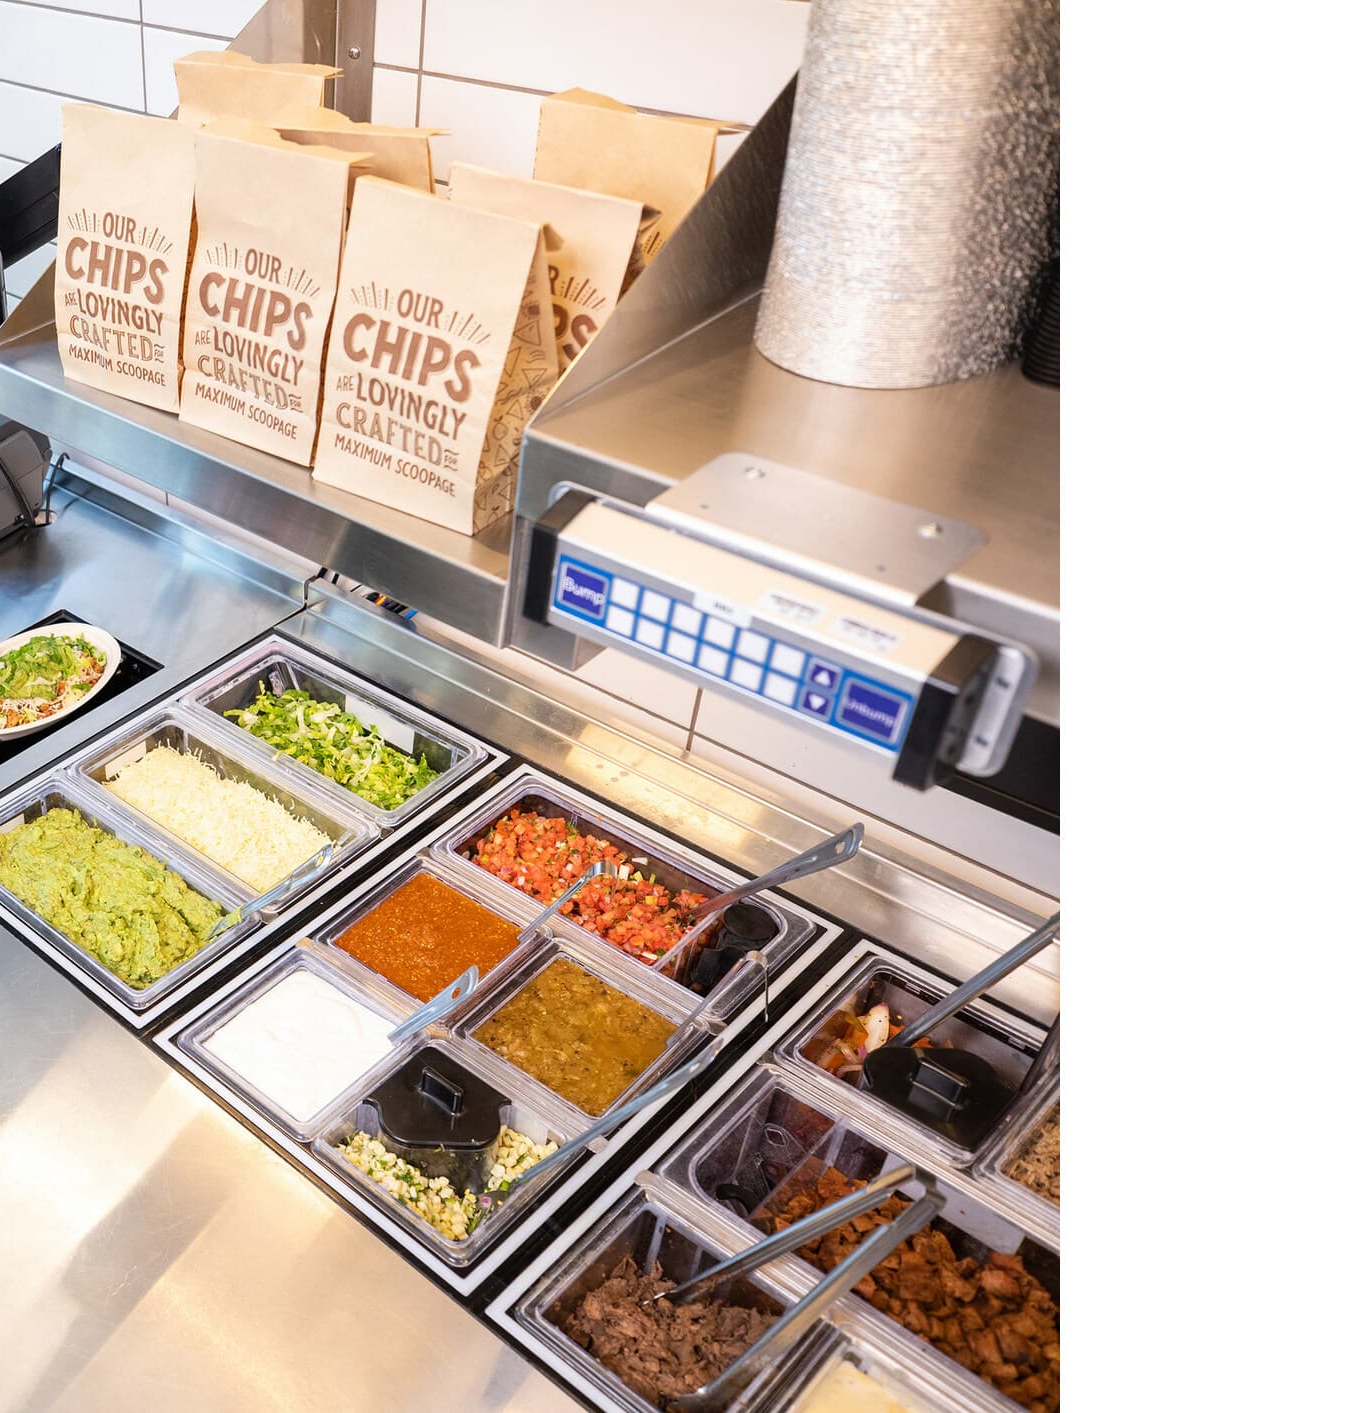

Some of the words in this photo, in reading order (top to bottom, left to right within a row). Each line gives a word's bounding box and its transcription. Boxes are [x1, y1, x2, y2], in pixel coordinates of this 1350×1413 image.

[102, 212, 136, 244] OUR
[65, 236, 169, 304] CHIPS
[245, 248, 282, 284] OUR
[65, 292, 77, 306] ARE
[77, 288, 163, 336] LOVINGLY
[199, 272, 313, 352] CHIPS
[397, 289, 443, 329] OUR
[69, 315, 153, 362] CRAFTED
[69, 344, 113, 372] MAXIMUM
[116, 361, 166, 386] SCOOPAGE
[195, 330, 211, 345] ARE
[213, 326, 304, 386] LOVINGLY
[343, 312, 481, 402] CHIPS
[197, 355, 290, 410] CRAFTED
[336, 376, 354, 391] ARE
[356, 372, 467, 441] LOVINGLY
[195, 382, 245, 416] MAXIMUM
[248, 405, 298, 440] SCOOPAGE
[336, 402, 443, 467] CRAFTED
[334, 433, 392, 471] MAXIMUM
[395, 459, 456, 498] SCOOPAGE
[562, 576, 605, 606] Bump
